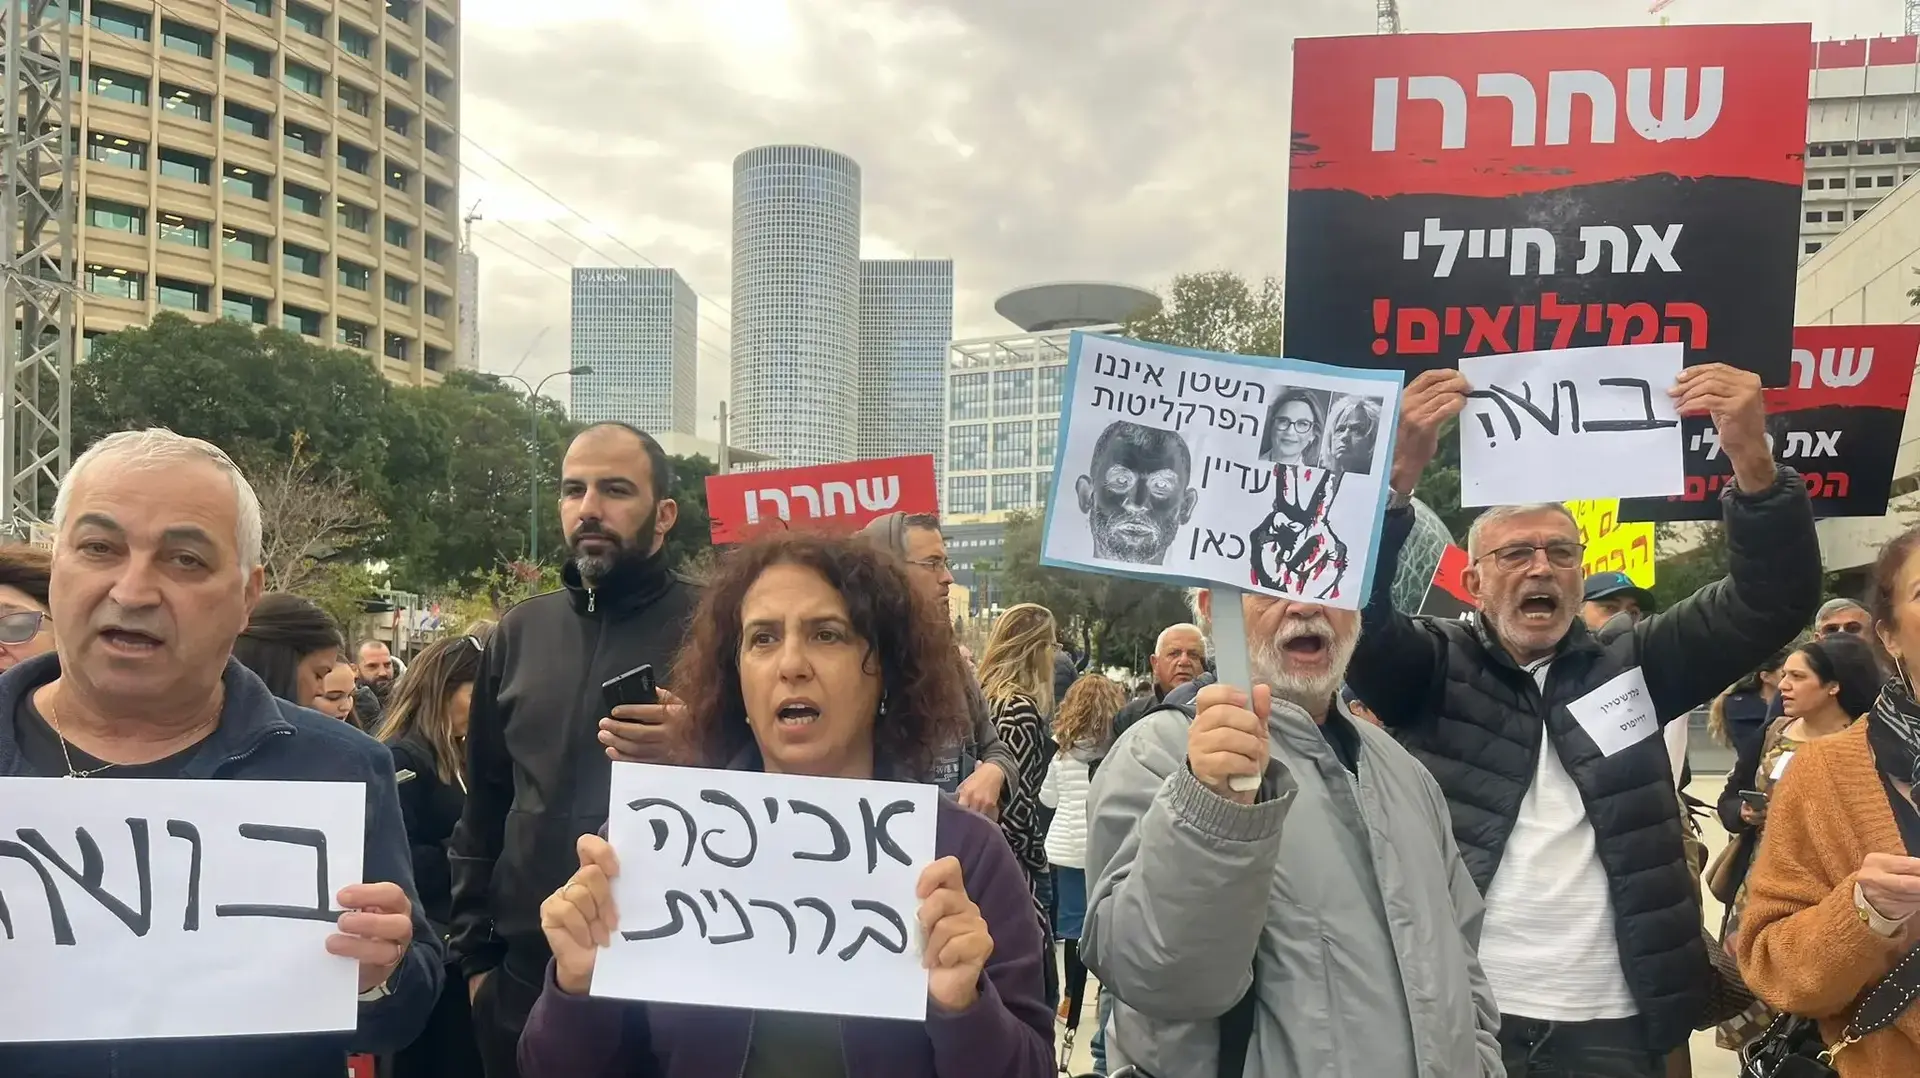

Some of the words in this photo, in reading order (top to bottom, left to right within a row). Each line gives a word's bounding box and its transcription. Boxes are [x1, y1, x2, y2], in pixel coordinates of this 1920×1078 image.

[1372, 67, 1724, 151] שחררו
[1404, 218, 1555, 277] חיילי
[1577, 224, 1683, 274] את
[1370, 292, 1709, 356] המילואים!
[1094, 353, 1165, 387] איננו
[1177, 371, 1266, 404] השטן
[1091, 386, 1259, 437] הפרקליטות
[1783, 430, 1842, 458] את
[1201, 456, 1271, 493] עדיין
[744, 475, 900, 525] שחררו
[1189, 527, 1245, 560] כאן
[626, 789, 916, 875] אכיפה
[0, 817, 352, 946] בושה
[621, 889, 908, 961] בררנית
